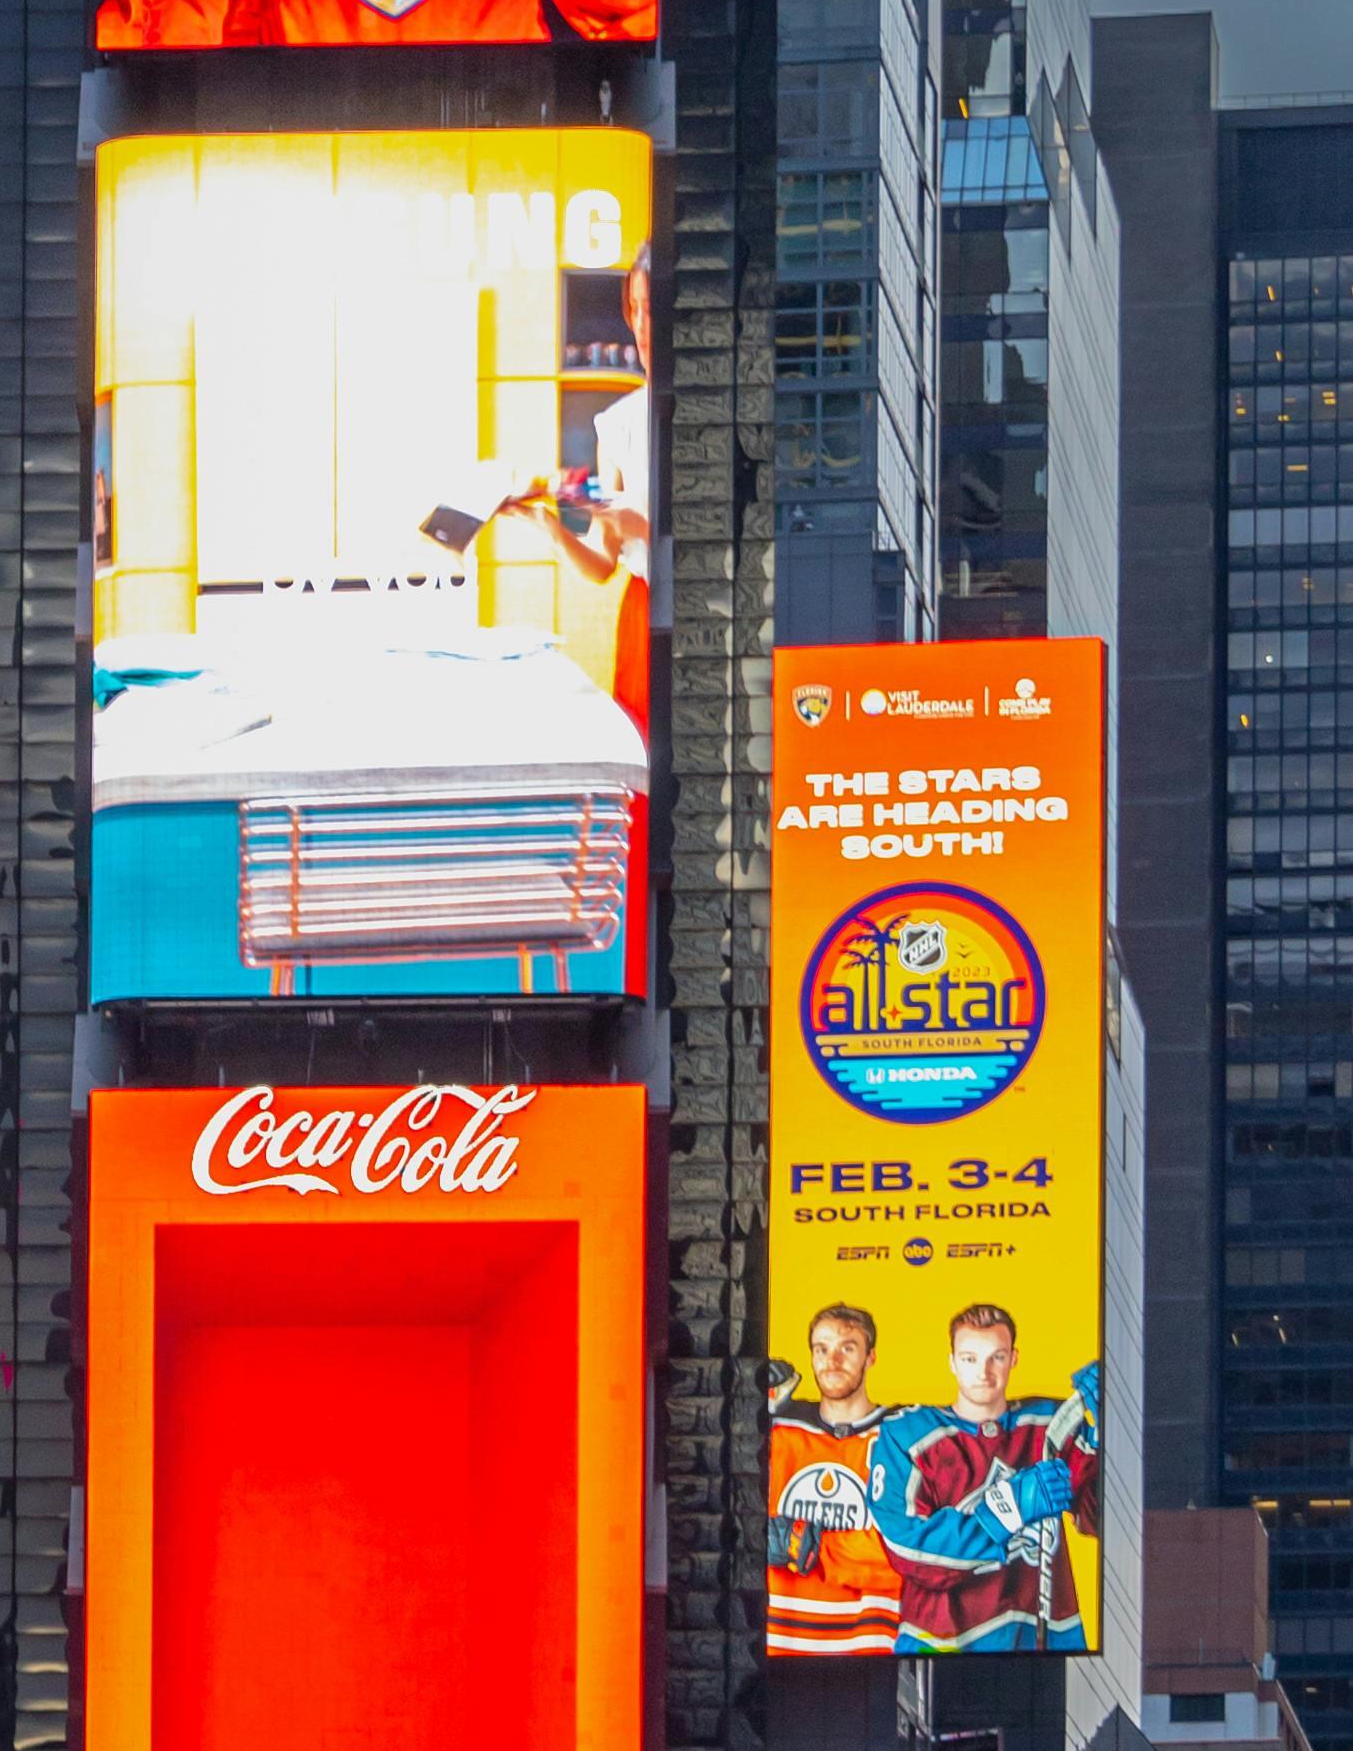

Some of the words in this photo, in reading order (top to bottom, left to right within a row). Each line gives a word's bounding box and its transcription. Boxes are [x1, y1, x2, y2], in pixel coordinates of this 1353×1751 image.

[887, 699, 974, 715] LAUDERDALE
[805, 772, 890, 798] THE
[898, 766, 1042, 795] STARS
[777, 804, 864, 830] ARE
[872, 797, 1069, 827] HEADING
[840, 831, 1005, 860] SOUTH!
[906, 932, 939, 966] NHL
[951, 966, 992, 978] 2023
[862, 1038, 913, 1050] SOUTH
[918, 1035, 983, 1049] FLORIDA
[888, 1066, 978, 1083] HONDA
[790, 1162, 930, 1194] FEB.
[947, 1156, 1054, 1191] 3-4
[794, 1205, 905, 1224] SOUTH
[915, 1201, 1052, 1221] FLORIDA
[836, 1245, 890, 1261] ESPN
[903, 1243, 934, 1260] abc
